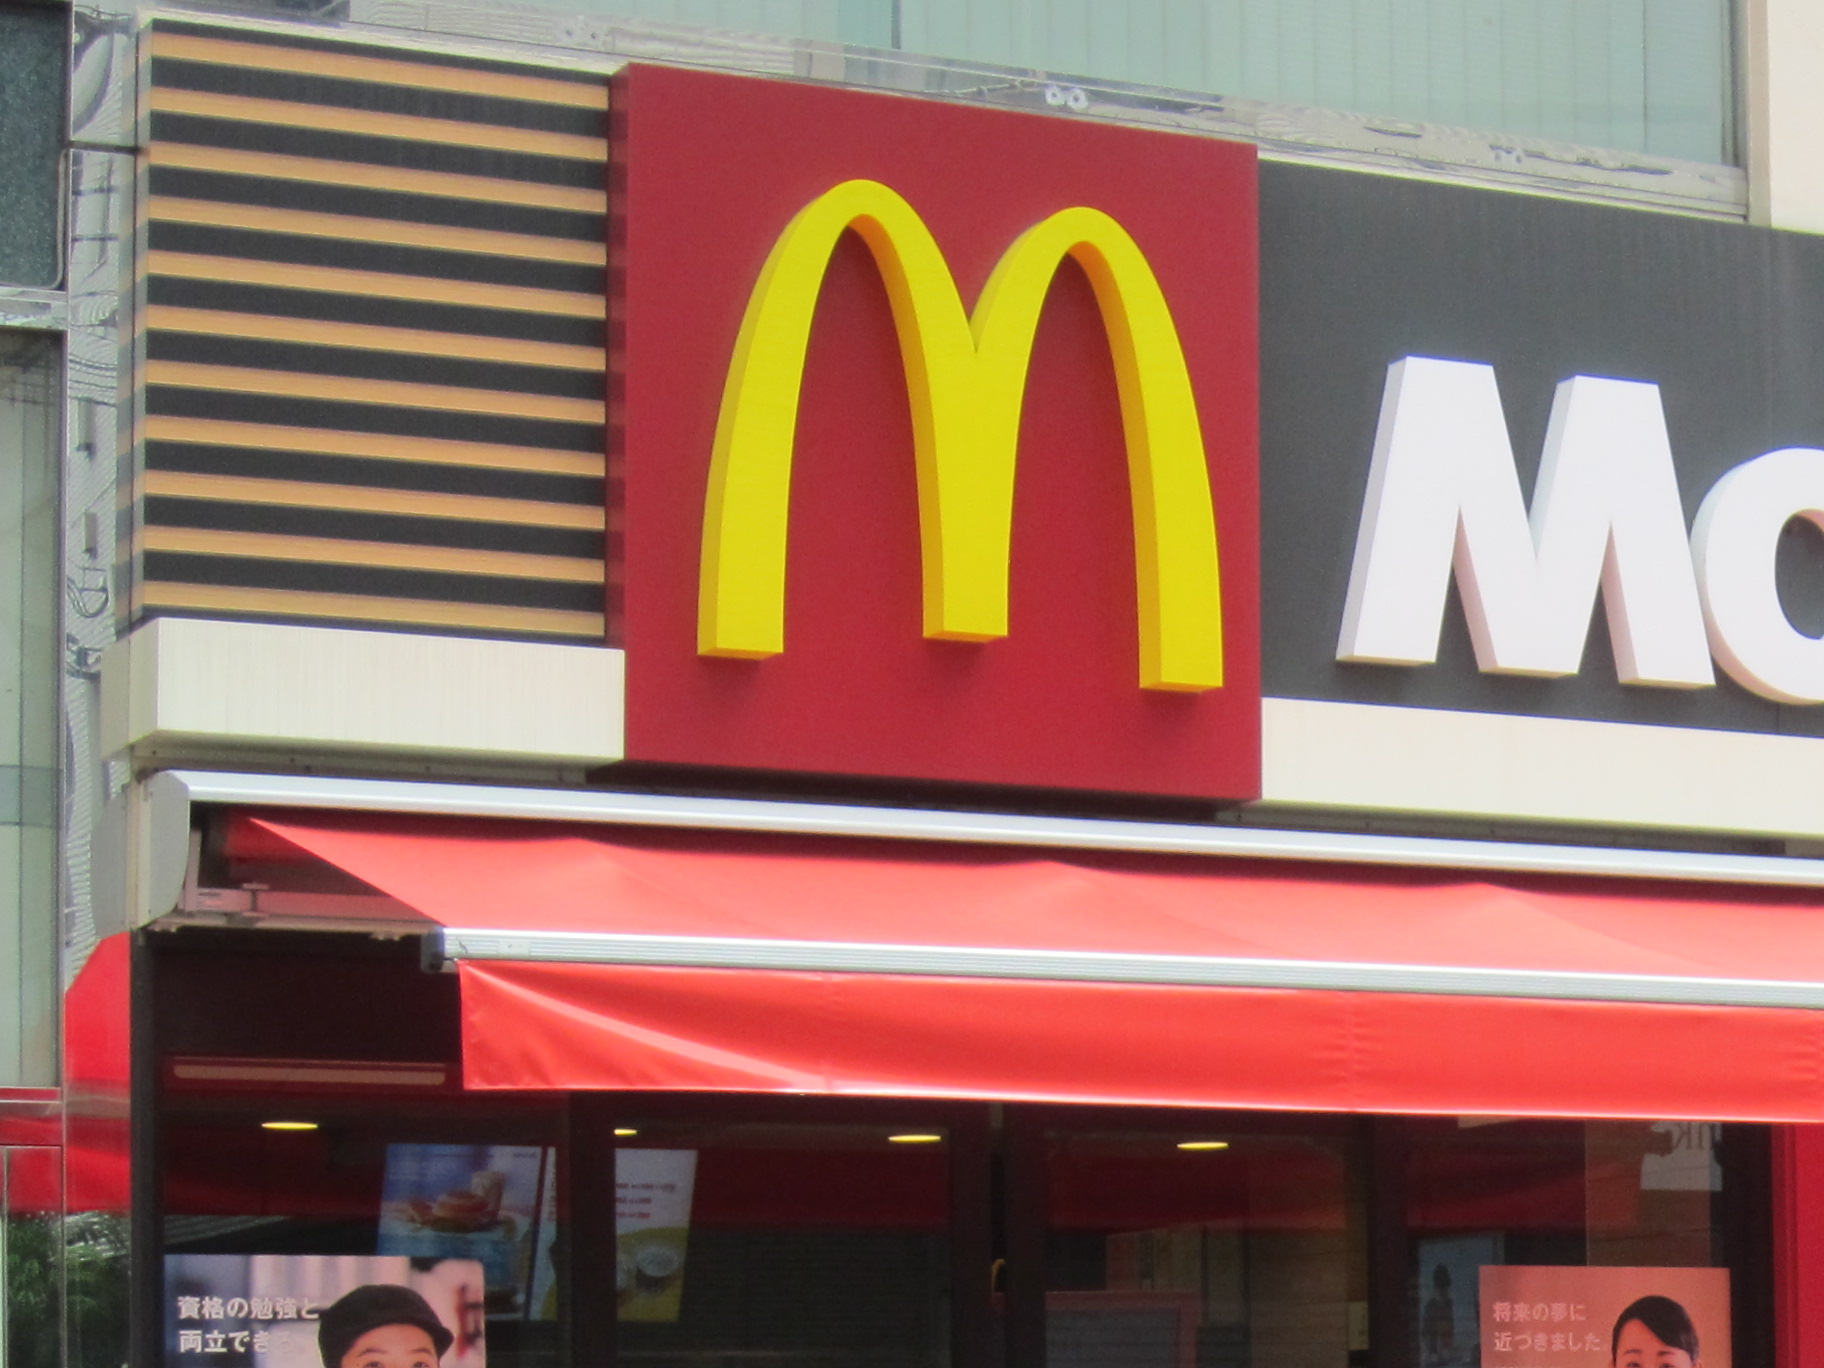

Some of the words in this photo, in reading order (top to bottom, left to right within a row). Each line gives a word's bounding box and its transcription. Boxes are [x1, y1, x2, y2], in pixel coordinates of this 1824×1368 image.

[178, 1296, 319, 1319] 資格の勉強と
[1492, 1302, 1587, 1322] 将来の夢に
[1493, 1331, 1607, 1352] 近づきました。
